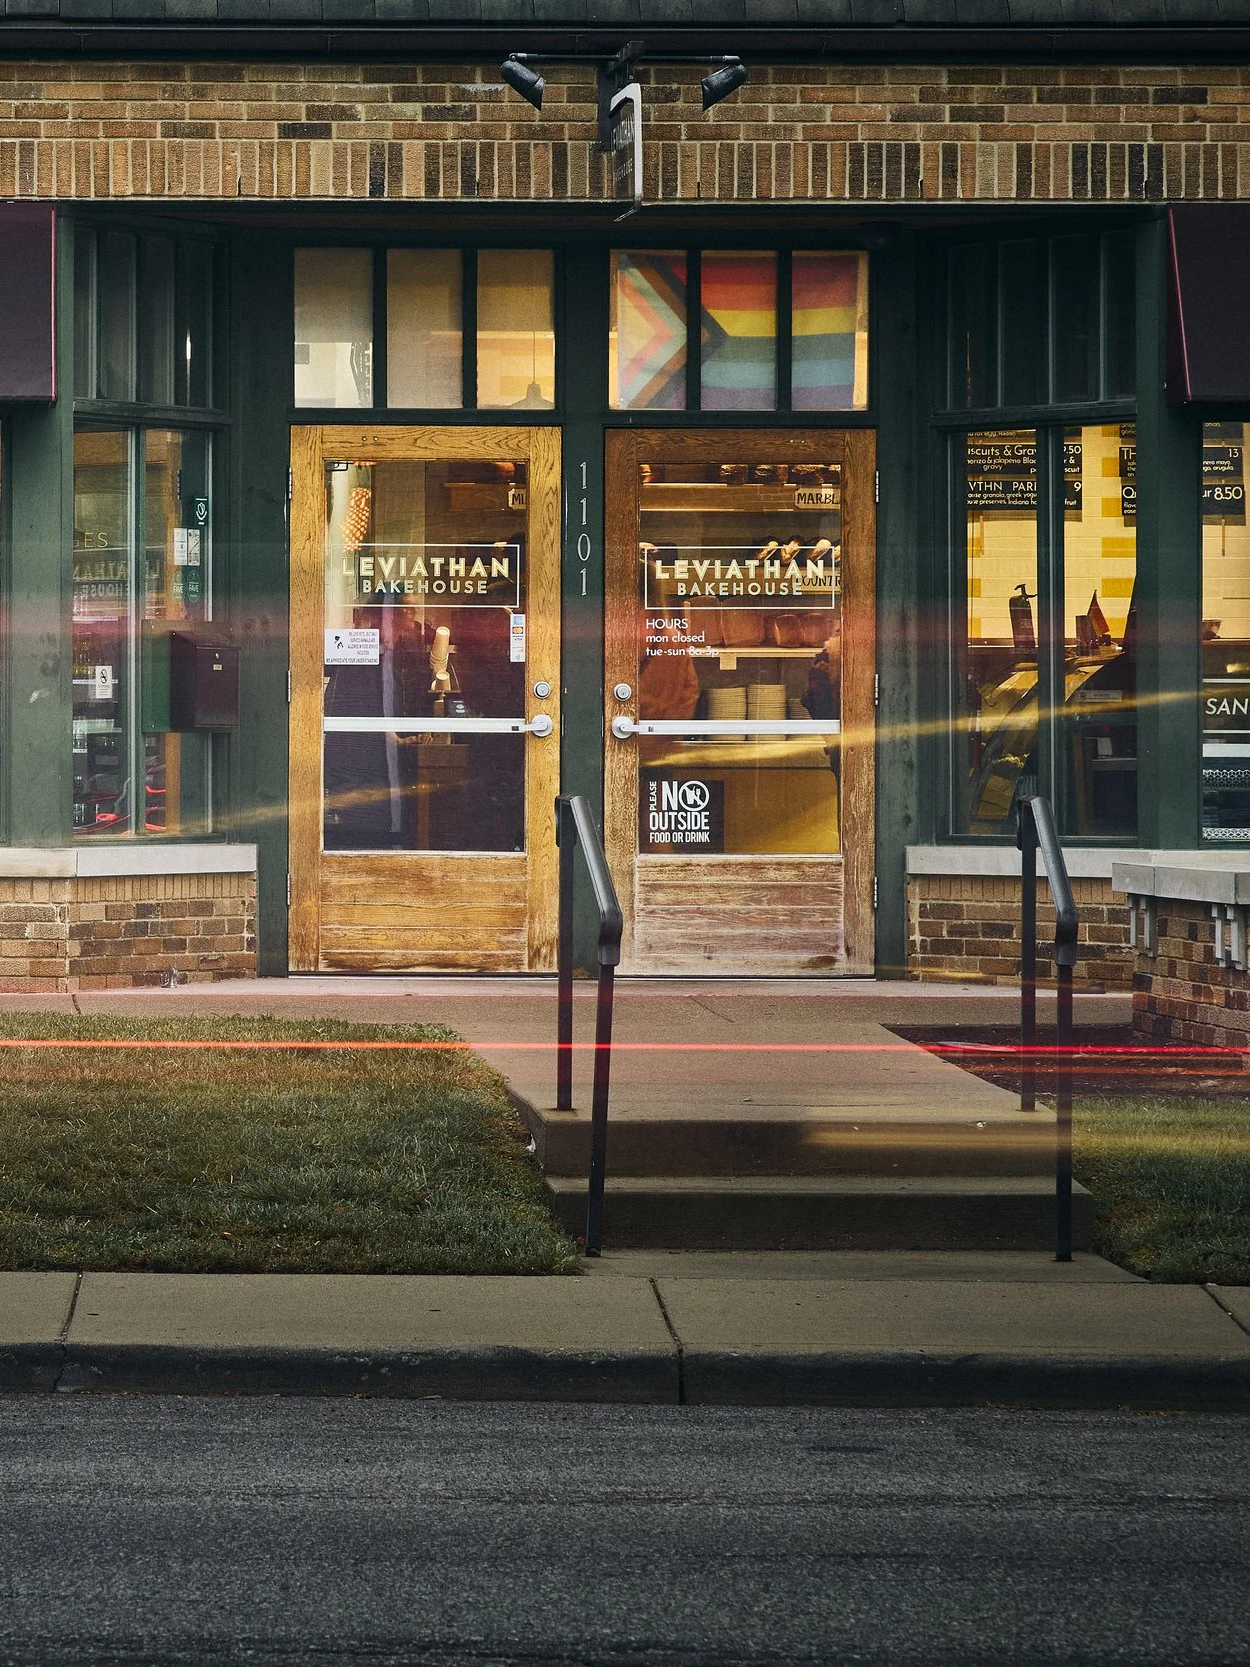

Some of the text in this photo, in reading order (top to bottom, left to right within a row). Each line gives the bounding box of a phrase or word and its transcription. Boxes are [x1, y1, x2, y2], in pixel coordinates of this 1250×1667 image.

[968, 446, 1000, 456] iscuits
[1004, 445, 1012, 456] &
[1228, 448, 1239, 458] 13
[1074, 482, 1081, 492] 9
[797, 492, 840, 505] MARBL
[578, 461, 591, 596] 1101
[342, 556, 510, 579] LEVIATHAN
[655, 559, 824, 582] LEVIATHAN
[362, 580, 488, 594] BAKEHOUSE
[677, 582, 803, 596] BAKEHOUSE
[646, 618, 688, 629] HOURS
[672, 631, 704, 642] closed
[646, 647, 685, 656] tue-sun
[1205, 698, 1248, 715] SAN
[650, 812, 710, 830] OUTSIDE
[650, 832, 710, 843] FOOD OR DRINK
